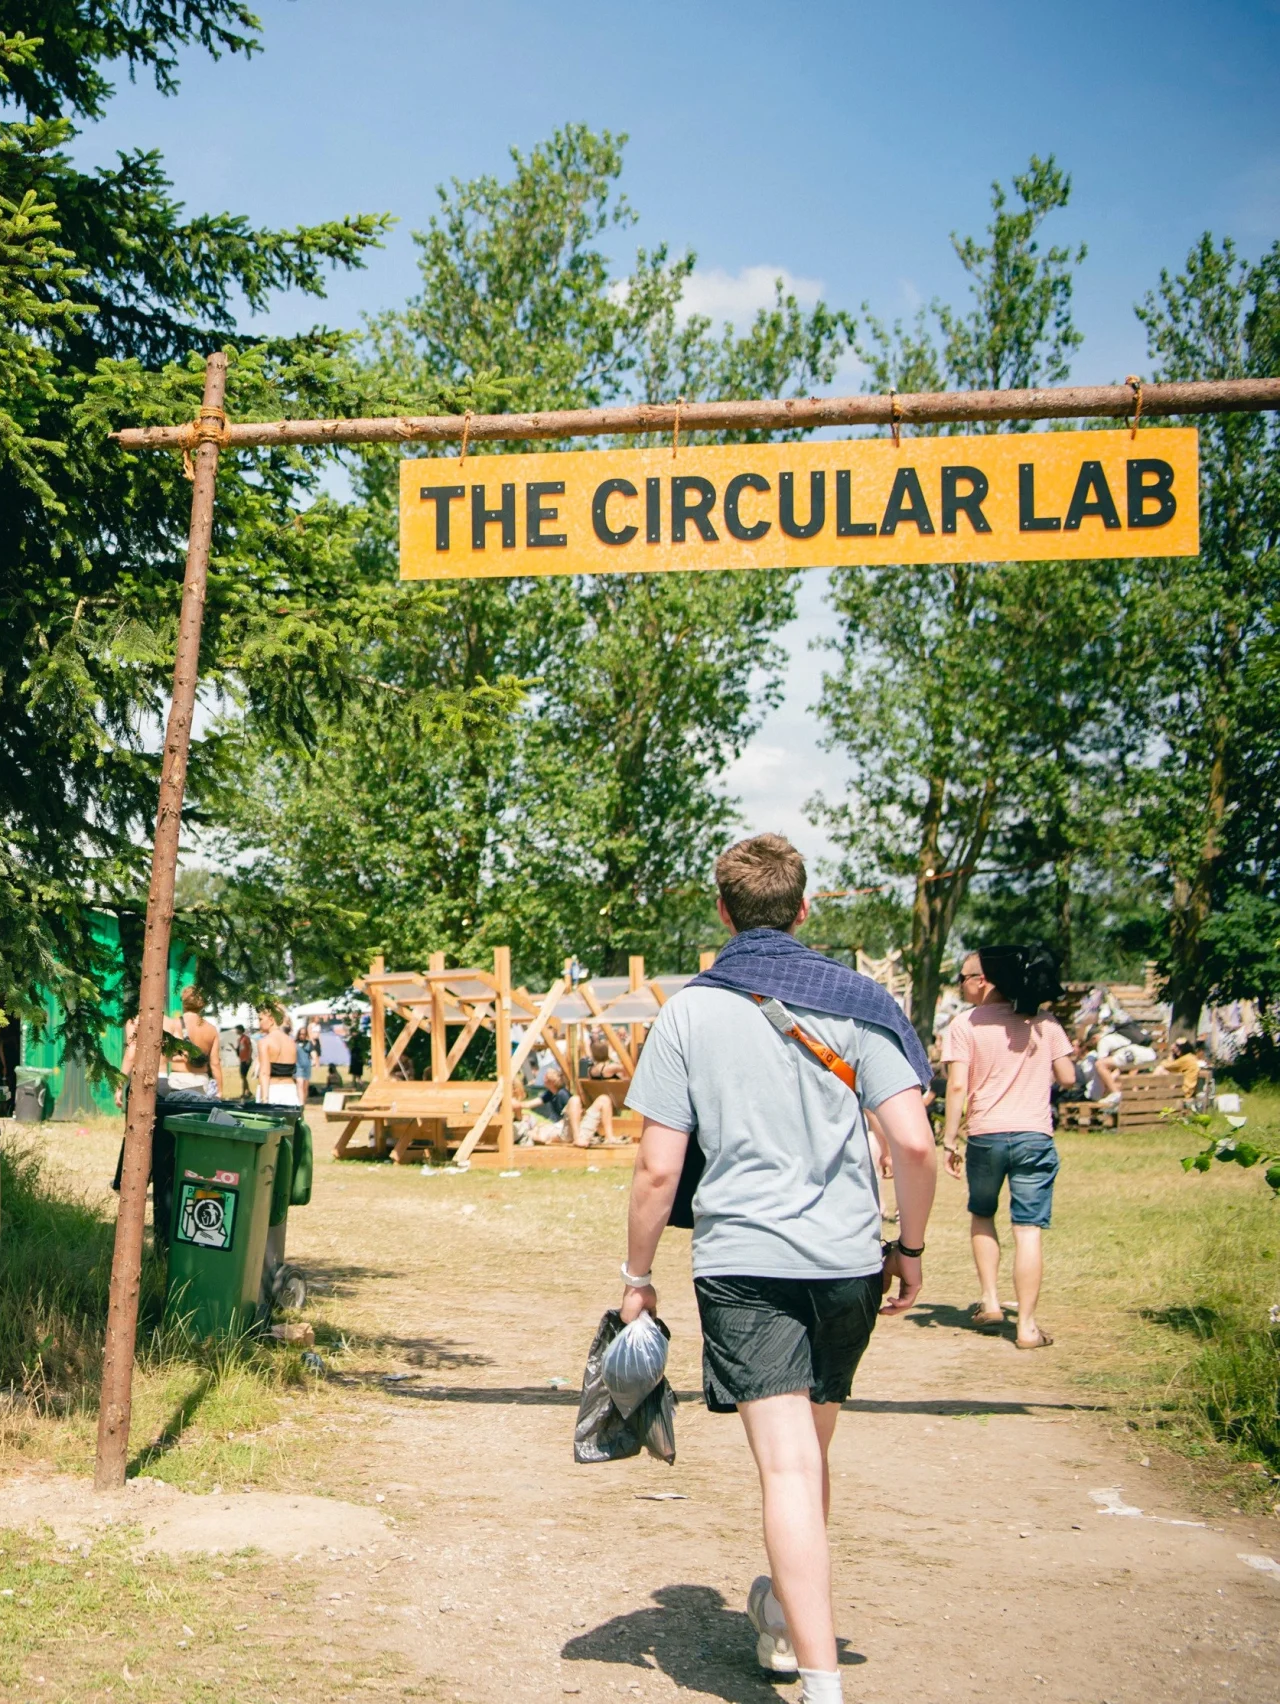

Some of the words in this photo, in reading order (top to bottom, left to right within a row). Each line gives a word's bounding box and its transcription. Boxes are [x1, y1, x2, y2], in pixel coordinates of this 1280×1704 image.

[420, 481, 567, 551] THE
[592, 465, 992, 545] CIRCULAR
[1018, 458, 1177, 531] LAB
